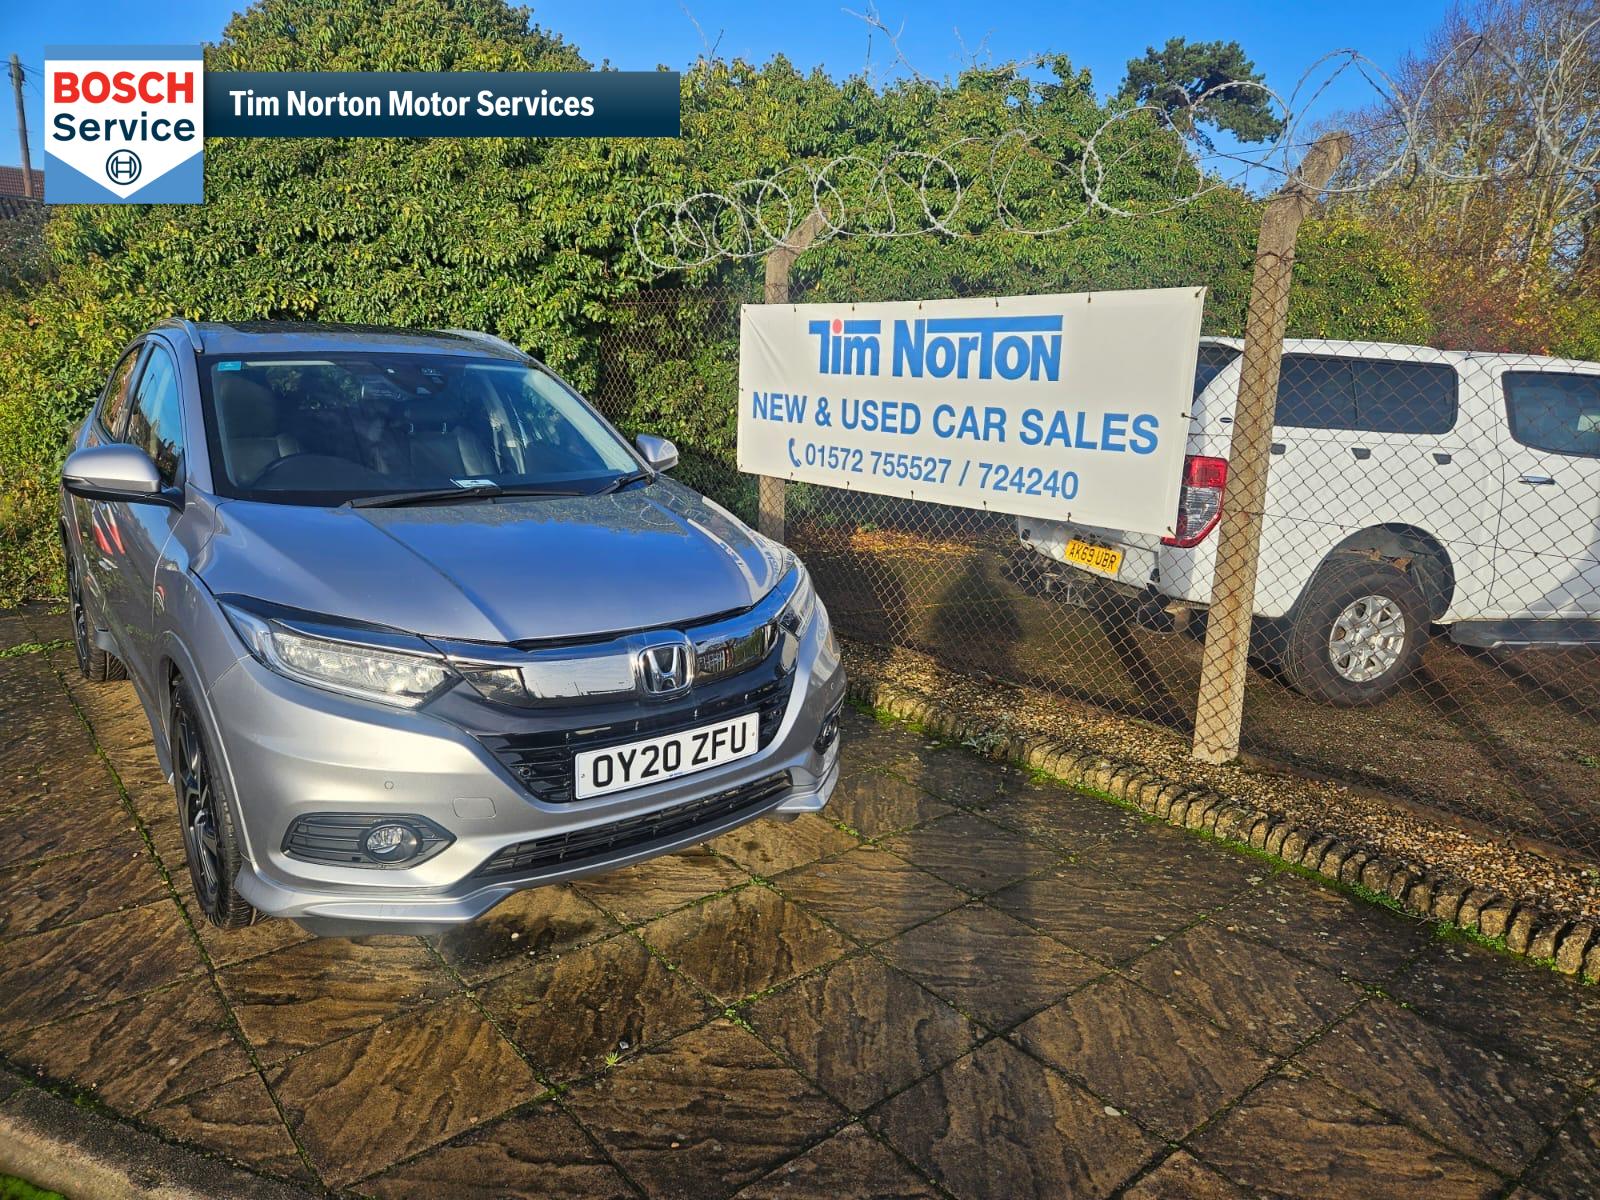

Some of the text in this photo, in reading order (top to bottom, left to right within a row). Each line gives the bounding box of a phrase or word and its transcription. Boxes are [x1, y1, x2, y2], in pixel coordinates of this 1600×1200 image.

[808, 319, 882, 376] Tim
[752, 391, 1159, 455] NEW & USED CAR SALES
[804, 443, 1080, 501] 01572 755527 / 724240
[1095, 551, 1117, 570] UBR
[592, 721, 748, 788] OY20 ZFU
